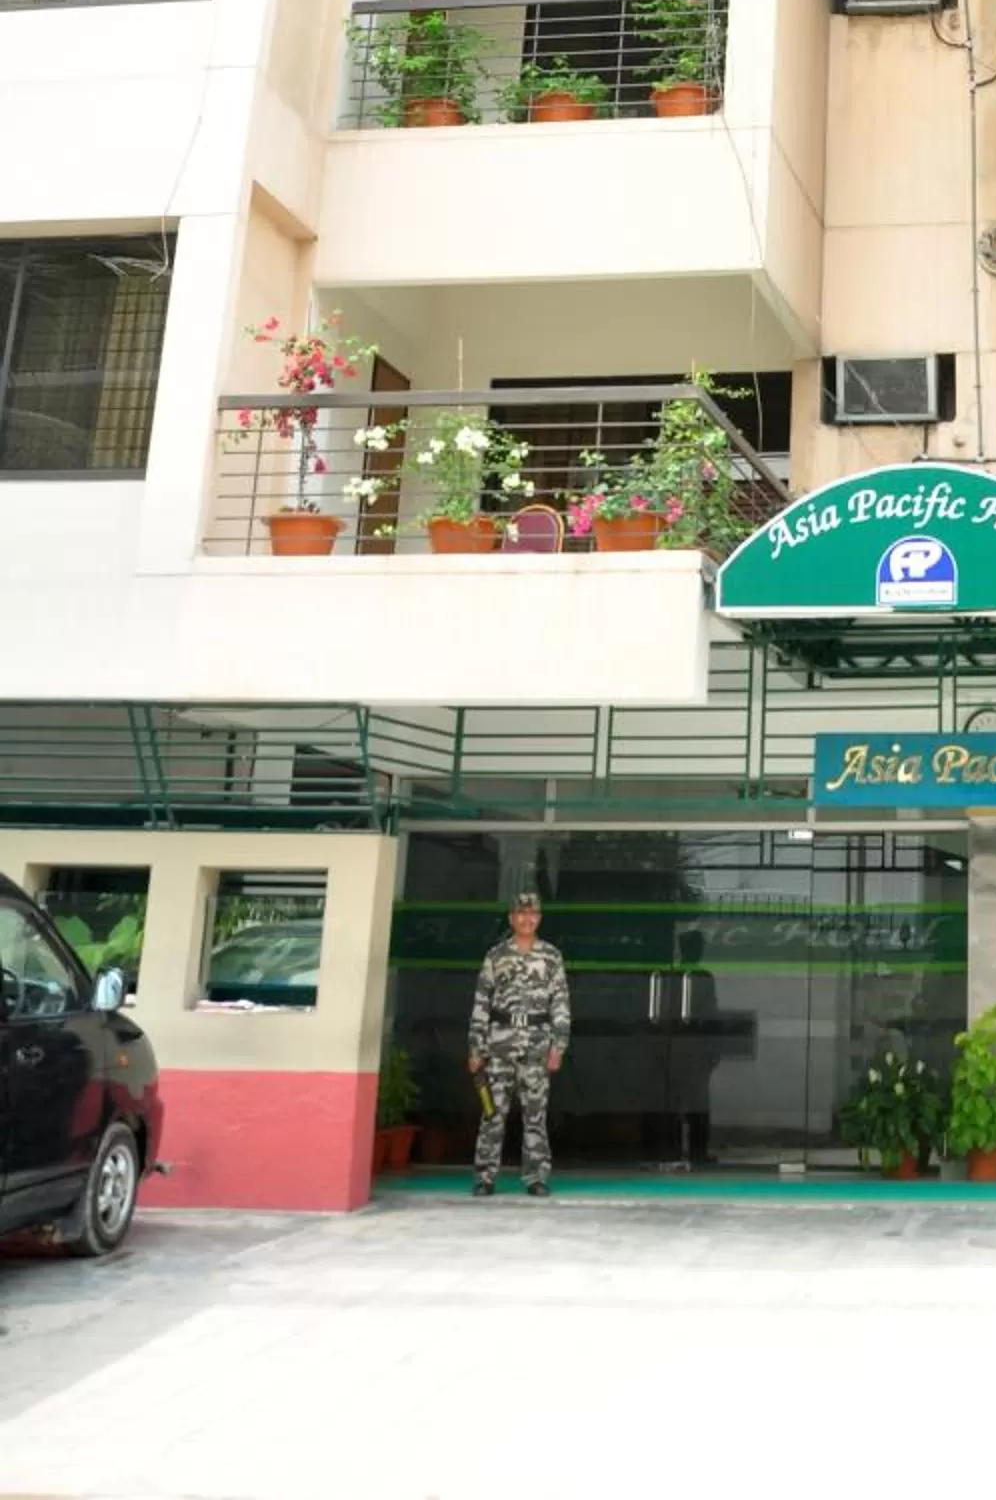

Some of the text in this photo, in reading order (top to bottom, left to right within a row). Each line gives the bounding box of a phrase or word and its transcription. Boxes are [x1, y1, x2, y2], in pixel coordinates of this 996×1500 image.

[767, 503, 842, 560] Asia
[848, 482, 966, 528] Pacific
[826, 742, 924, 790] Asia
